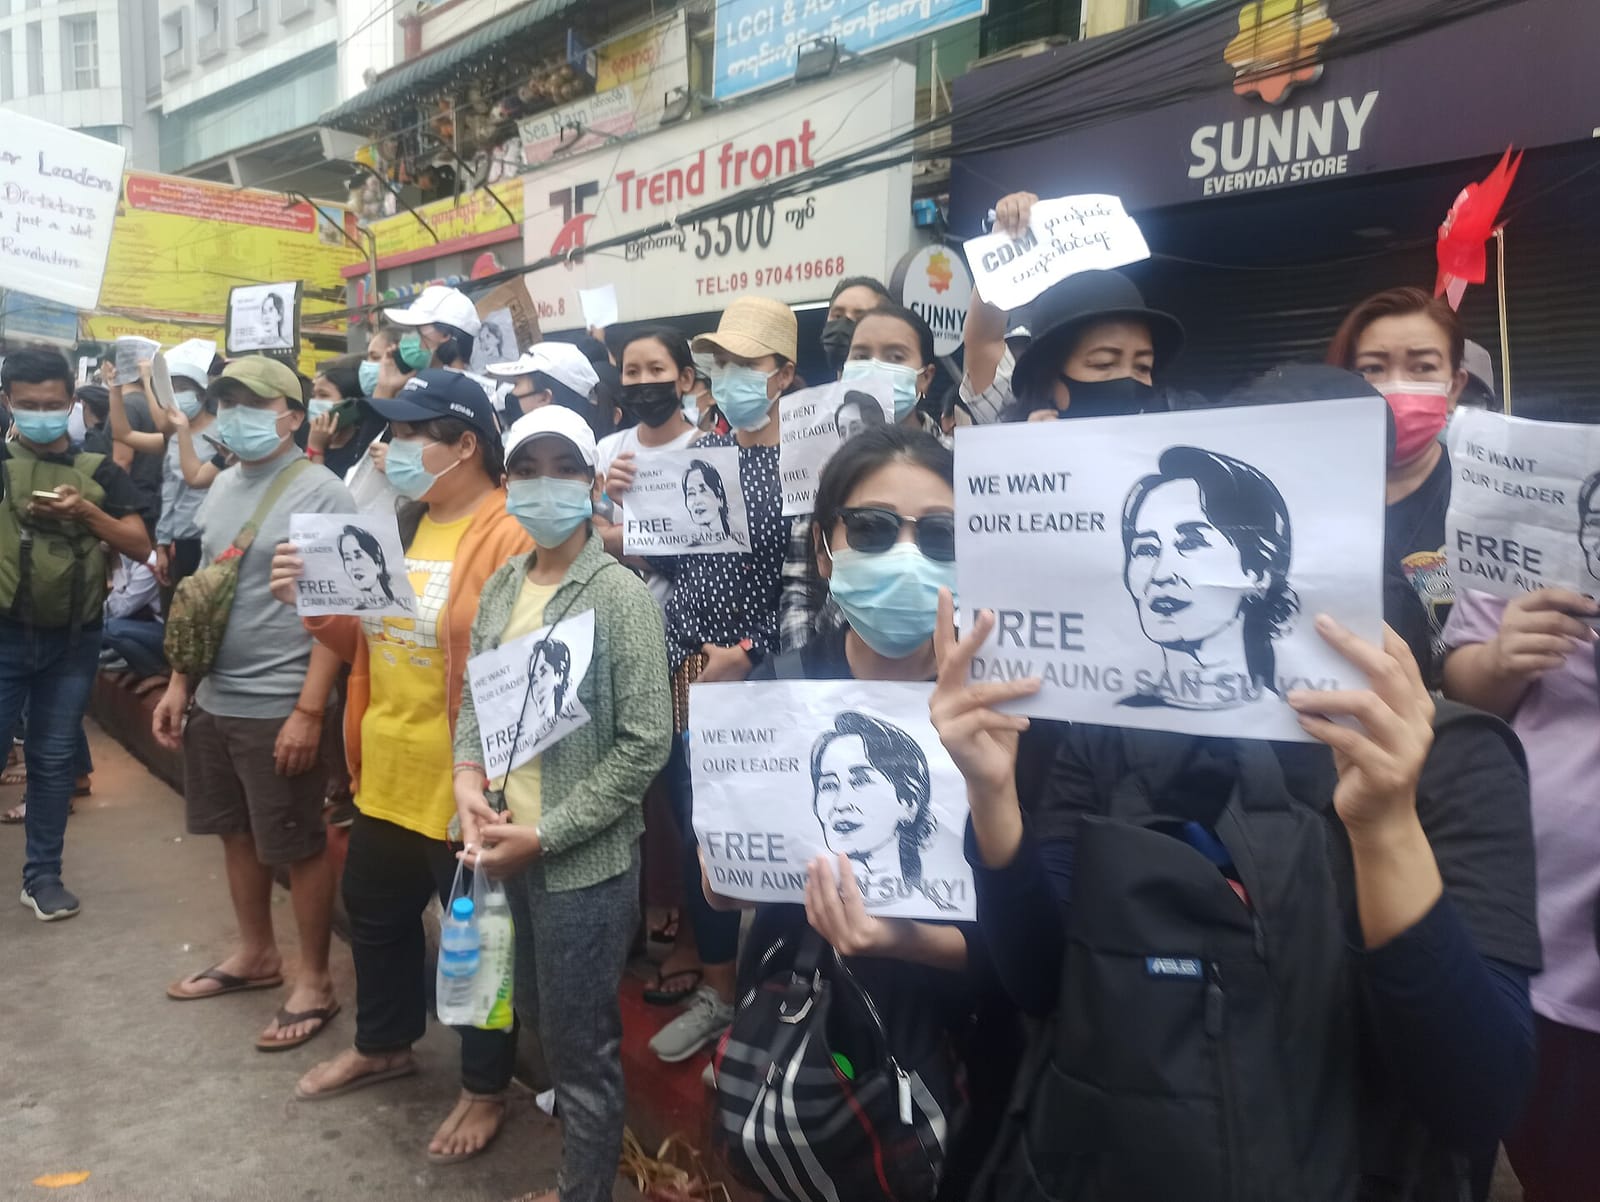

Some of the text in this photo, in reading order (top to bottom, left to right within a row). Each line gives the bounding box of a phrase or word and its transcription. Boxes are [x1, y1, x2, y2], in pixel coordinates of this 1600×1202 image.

[727, 6, 774, 48] LCCI
[782, 0, 796, 26] &
[523, 119, 549, 143] Sea
[551, 104, 589, 134] Rain
[1188, 91, 1379, 179] SUNNY
[39, 150, 113, 192] Leaders
[615, 119, 816, 213] Trend front
[1203, 154, 1348, 196] EVERYDAY STORE
[982, 226, 1039, 274] CDM
[696, 256, 846, 297] TEL:09 970419668
[796, 423, 836, 441] LEADER
[1466, 440, 1538, 473] WE WANT
[639, 470, 662, 479] WANT
[645, 482, 677, 492] LEADER
[784, 468, 809, 482] FREE
[968, 472, 1072, 496] WE WANT
[1461, 467, 1566, 505] OUR LEADER
[787, 490, 810, 503] DAW
[628, 517, 673, 533] FREE
[968, 510, 1106, 535] OUR LEADER
[628, 536, 655, 546] DAW
[657, 534, 689, 546] AUNG
[690, 531, 713, 542] SAN
[1457, 529, 1543, 576] FREE
[1459, 557, 1506, 583] DAW
[297, 580, 339, 594] FREE
[474, 664, 512, 689] WE WANT
[971, 655, 1033, 682] DAW
[1041, 661, 1123, 694] AUNG
[1133, 669, 1201, 703] SAN
[1215, 672, 1264, 703] SU
[478, 690, 495, 705] OUR
[486, 720, 526, 753] FREE
[702, 727, 777, 745] WE WANT
[702, 757, 801, 773] OUR LEADER
[705, 831, 788, 865] FREE
[714, 866, 754, 889] DAW
[760, 872, 810, 891] AUN
[879, 877, 914, 899] SU
